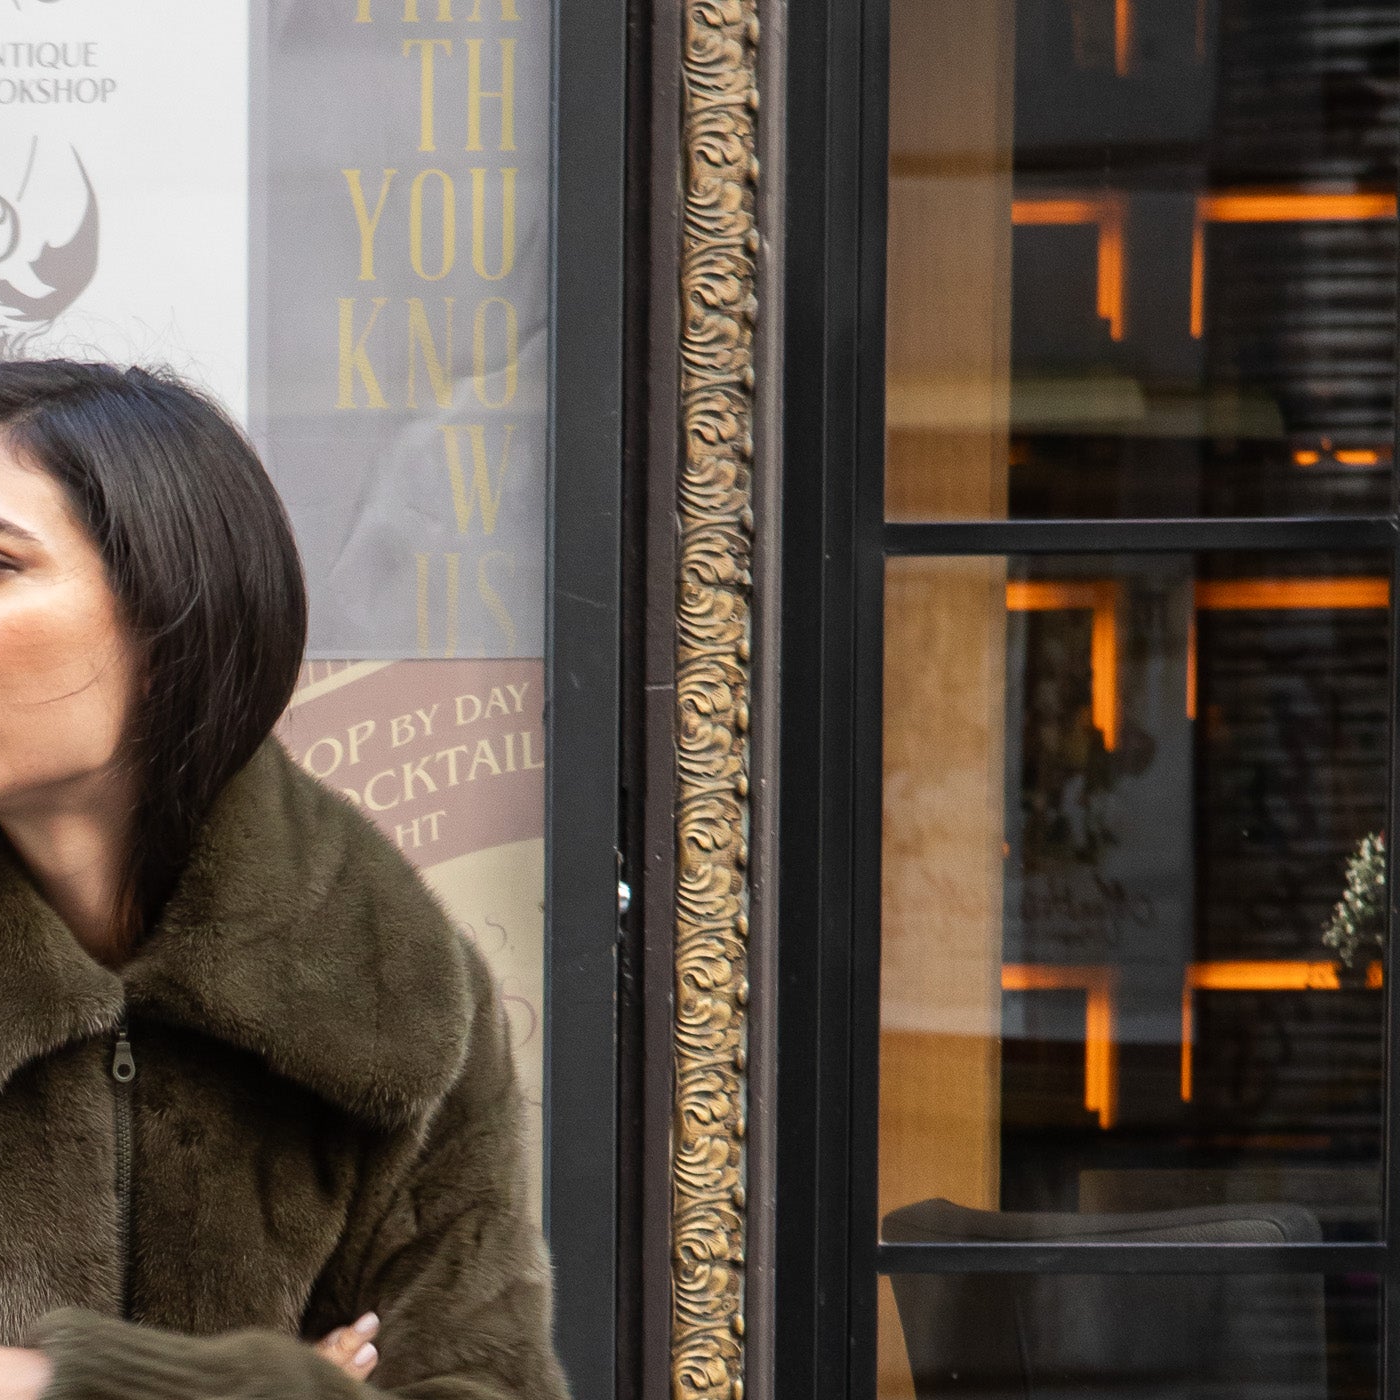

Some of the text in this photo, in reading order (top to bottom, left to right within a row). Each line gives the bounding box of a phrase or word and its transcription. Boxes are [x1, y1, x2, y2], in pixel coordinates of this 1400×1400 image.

[401, 38, 518, 151] TH
[341, 168, 518, 281] YOU
[335, 297, 519, 410] KNO
[437, 424, 516, 536] W
[390, 704, 439, 748] BY
[455, 682, 530, 726] DAY
